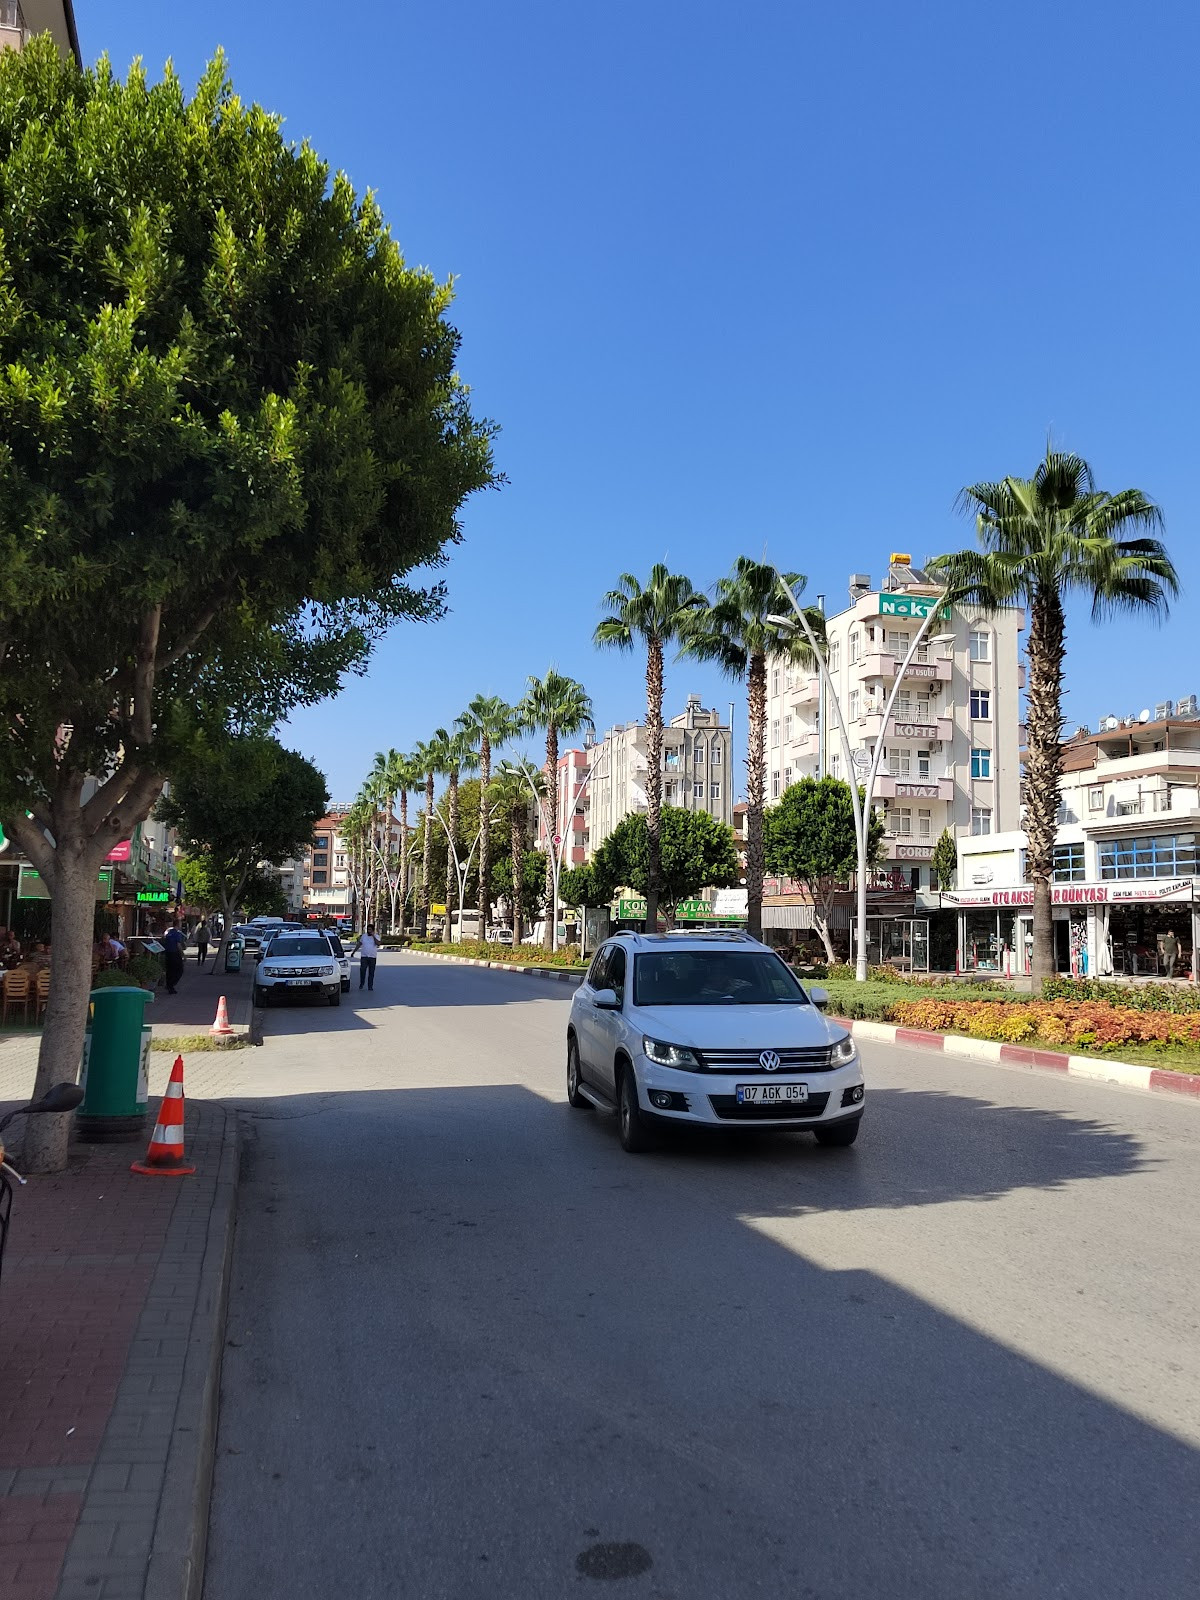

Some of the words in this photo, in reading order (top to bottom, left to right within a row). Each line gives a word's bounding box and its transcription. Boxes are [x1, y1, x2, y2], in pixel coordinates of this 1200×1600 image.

[896, 725, 935, 737] KÖFTE
[992, 892, 1009, 904] OTO
[744, 1087, 758, 1099] 07
[762, 1087, 781, 1099] AGK
[786, 1086, 805, 1099] 054
